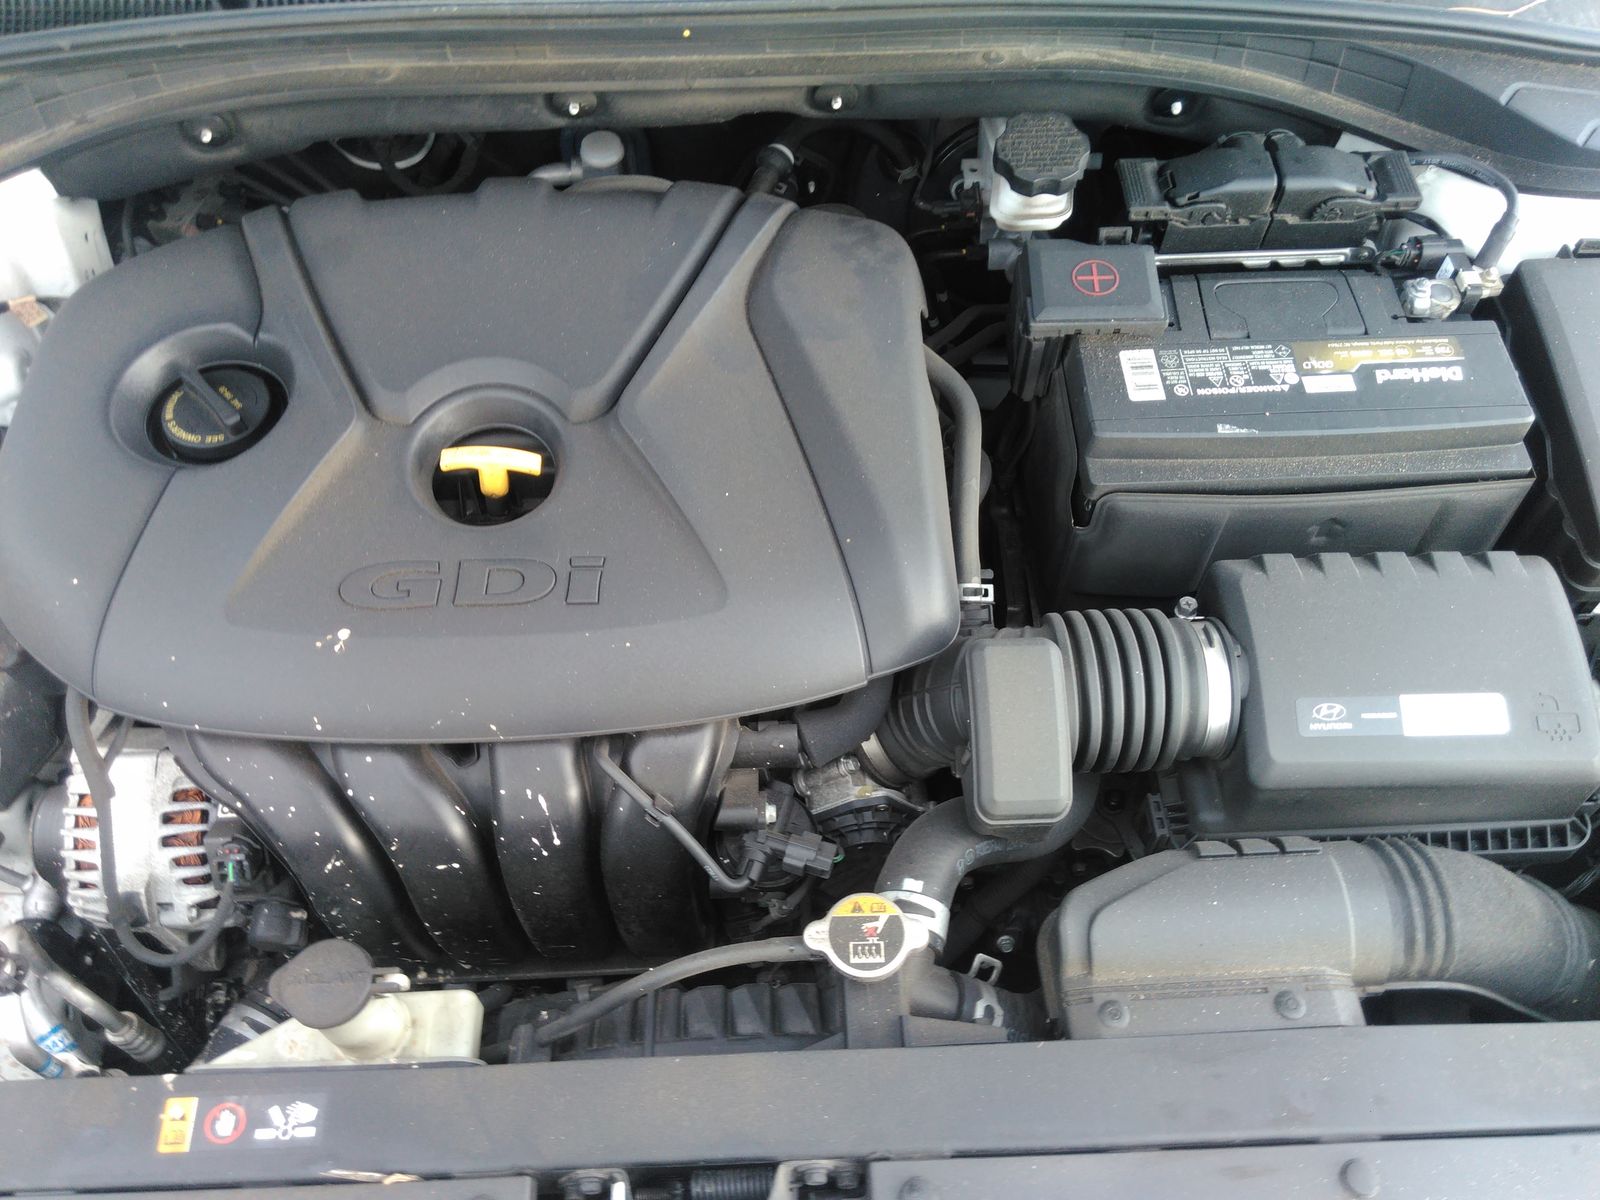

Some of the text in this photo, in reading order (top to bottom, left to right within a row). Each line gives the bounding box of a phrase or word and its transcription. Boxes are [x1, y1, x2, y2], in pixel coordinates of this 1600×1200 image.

[1303, 359, 1334, 369] GOLD
[1375, 366, 1463, 384] DieHard
[338, 556, 606, 610] GDi
